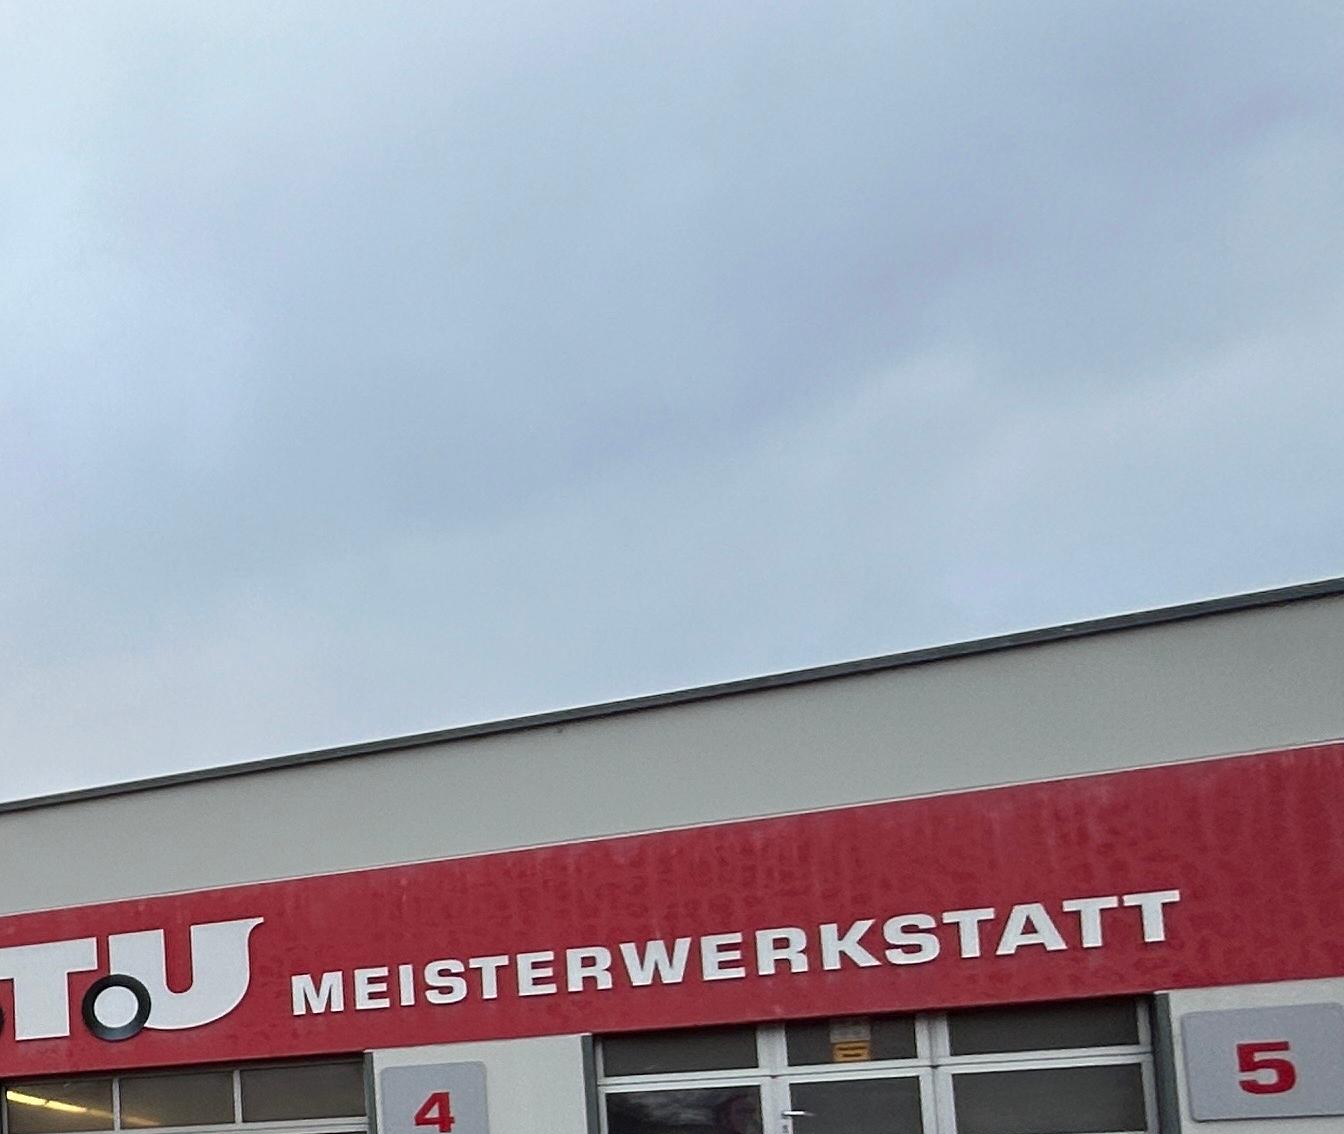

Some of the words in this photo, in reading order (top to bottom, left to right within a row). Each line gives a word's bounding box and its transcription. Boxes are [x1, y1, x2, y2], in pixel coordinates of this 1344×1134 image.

[291, 889, 1181, 1016] MEISTERWERKSTATT
[1236, 1041, 1297, 1096] 5
[414, 1091, 455, 1134] 4
